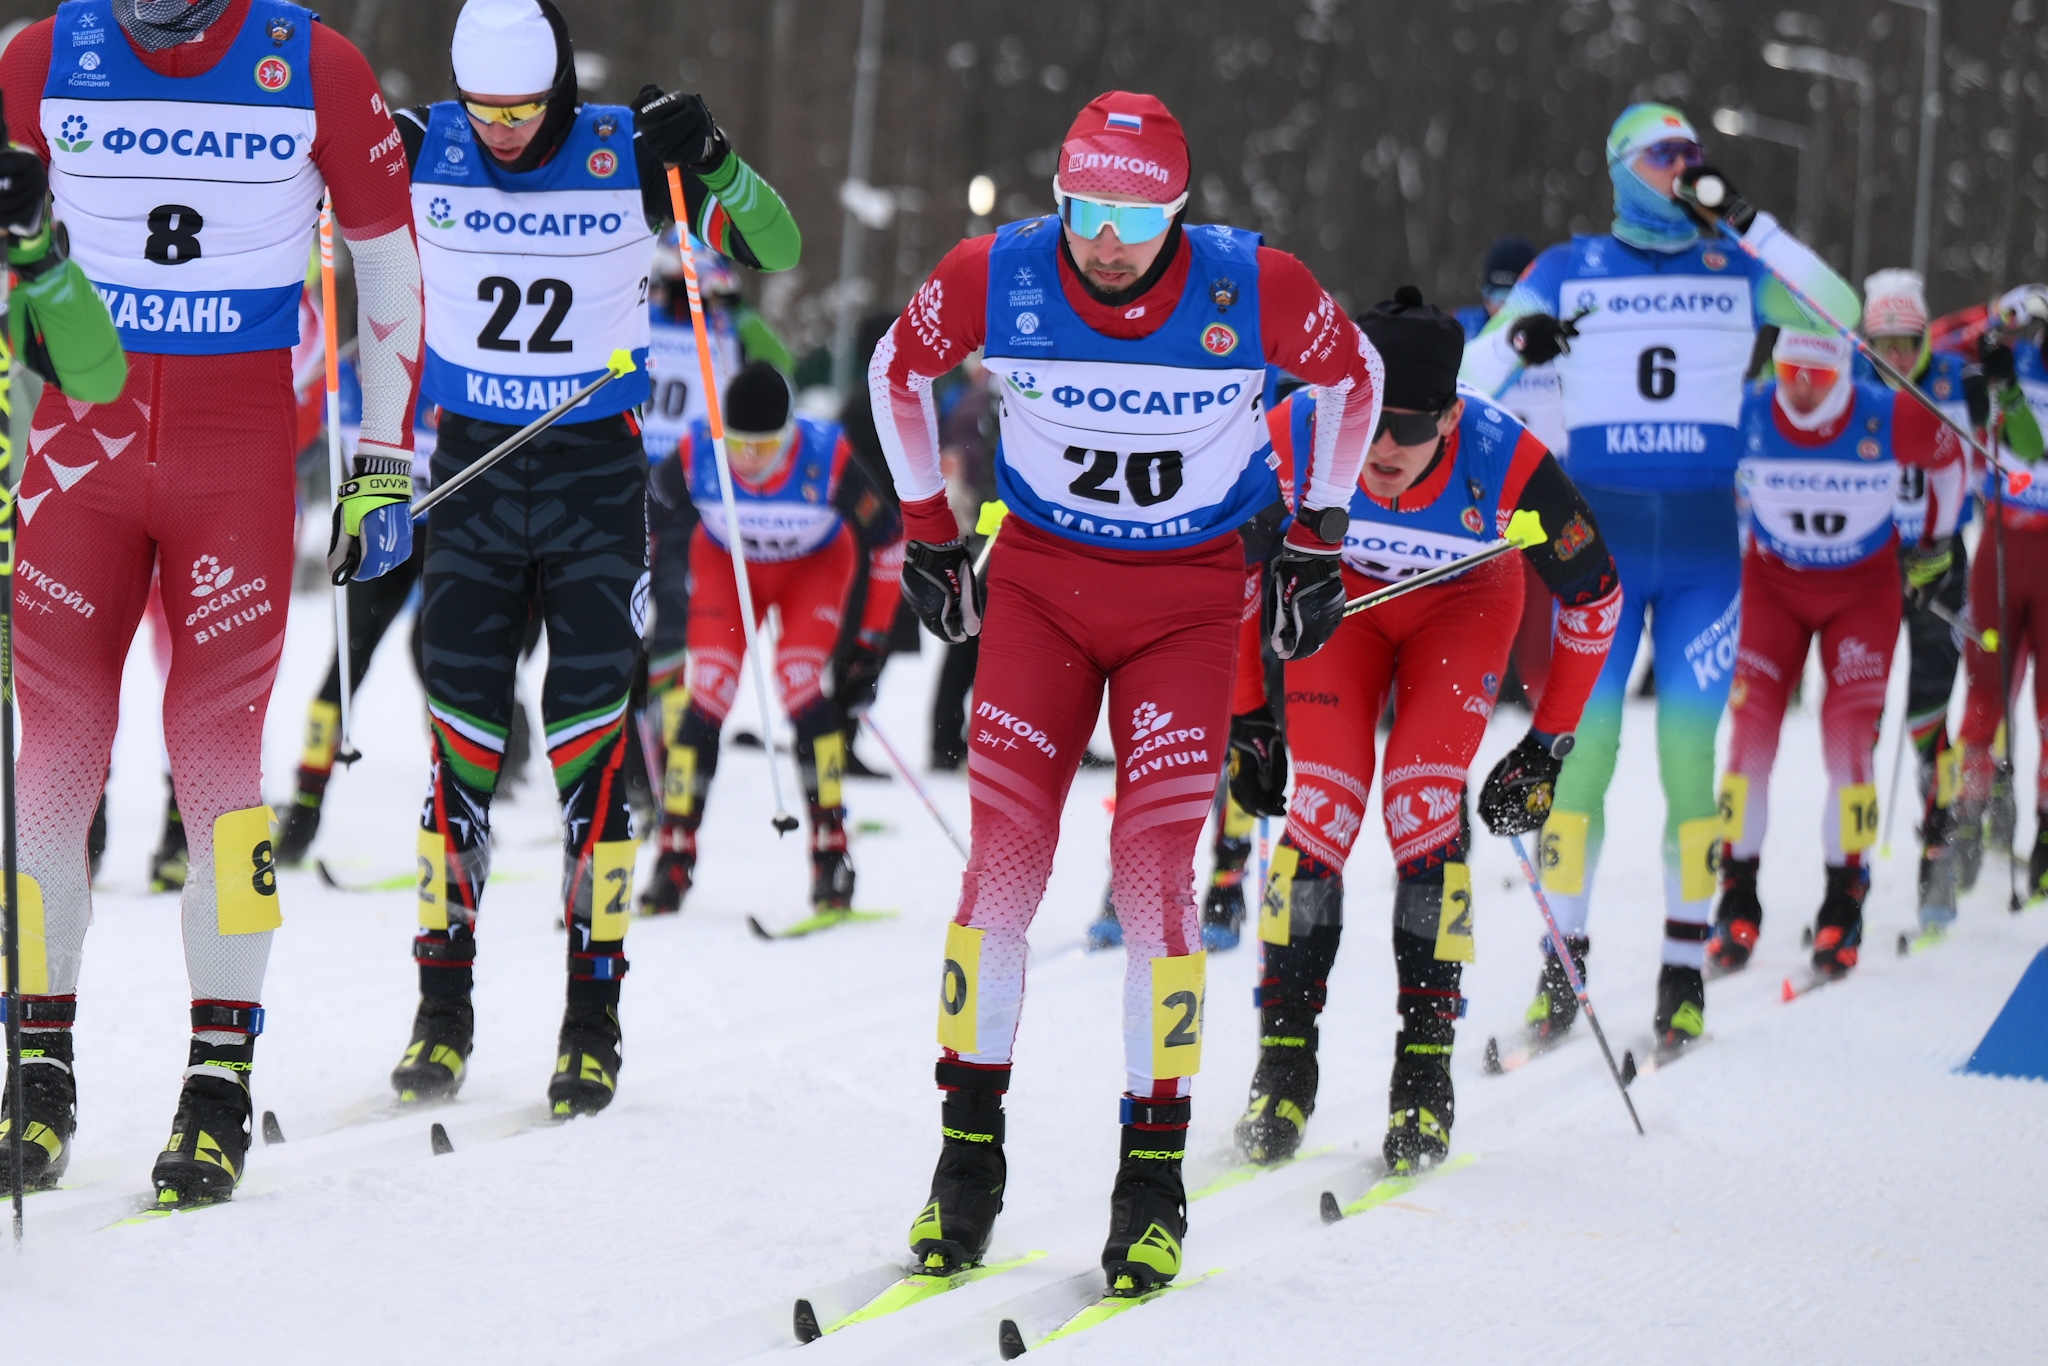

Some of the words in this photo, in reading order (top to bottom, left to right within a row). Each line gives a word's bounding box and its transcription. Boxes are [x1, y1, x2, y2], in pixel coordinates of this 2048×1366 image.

[68, 78, 110, 87] Компания
[72, 72, 106, 80] Сетевая
[102, 127, 297, 160] ФОСАГРО
[1084, 153, 1169, 184] ЛУКОЙЛ
[143, 203, 204, 266] 8
[464, 209, 622, 237] ФОСАГРО
[476, 276, 573, 353] 22
[1608, 293, 1734, 315] ФОСАГРО
[466, 372, 592, 411] КАЗАНЬ
[1637, 346, 1677, 402] 6
[1052, 383, 1241, 416] ФОСАГРО
[1606, 424, 1706, 454] КАЗАНЬ
[1063, 445, 1184, 507] 20
[16, 589, 54, 616] ЭН+
[17, 560, 96, 619] ЛУКОЙЛ
[185, 577, 267, 627] ФОСАГРО
[194, 599, 272, 645] BIVIUM
[976, 701, 1058, 759] ЛУКОЙЛ
[976, 729, 1019, 752] ЭН+
[1125, 727, 1205, 769] ФОСАГРО
[1128, 749, 1209, 783] BIVIUM
[252, 839, 277, 896] 8
[417, 855, 436, 904] 2
[604, 866, 634, 915] 2
[1447, 889, 1472, 936] 2
[940, 958, 967, 1016] 0
[1161, 986, 1205, 1048] 2
